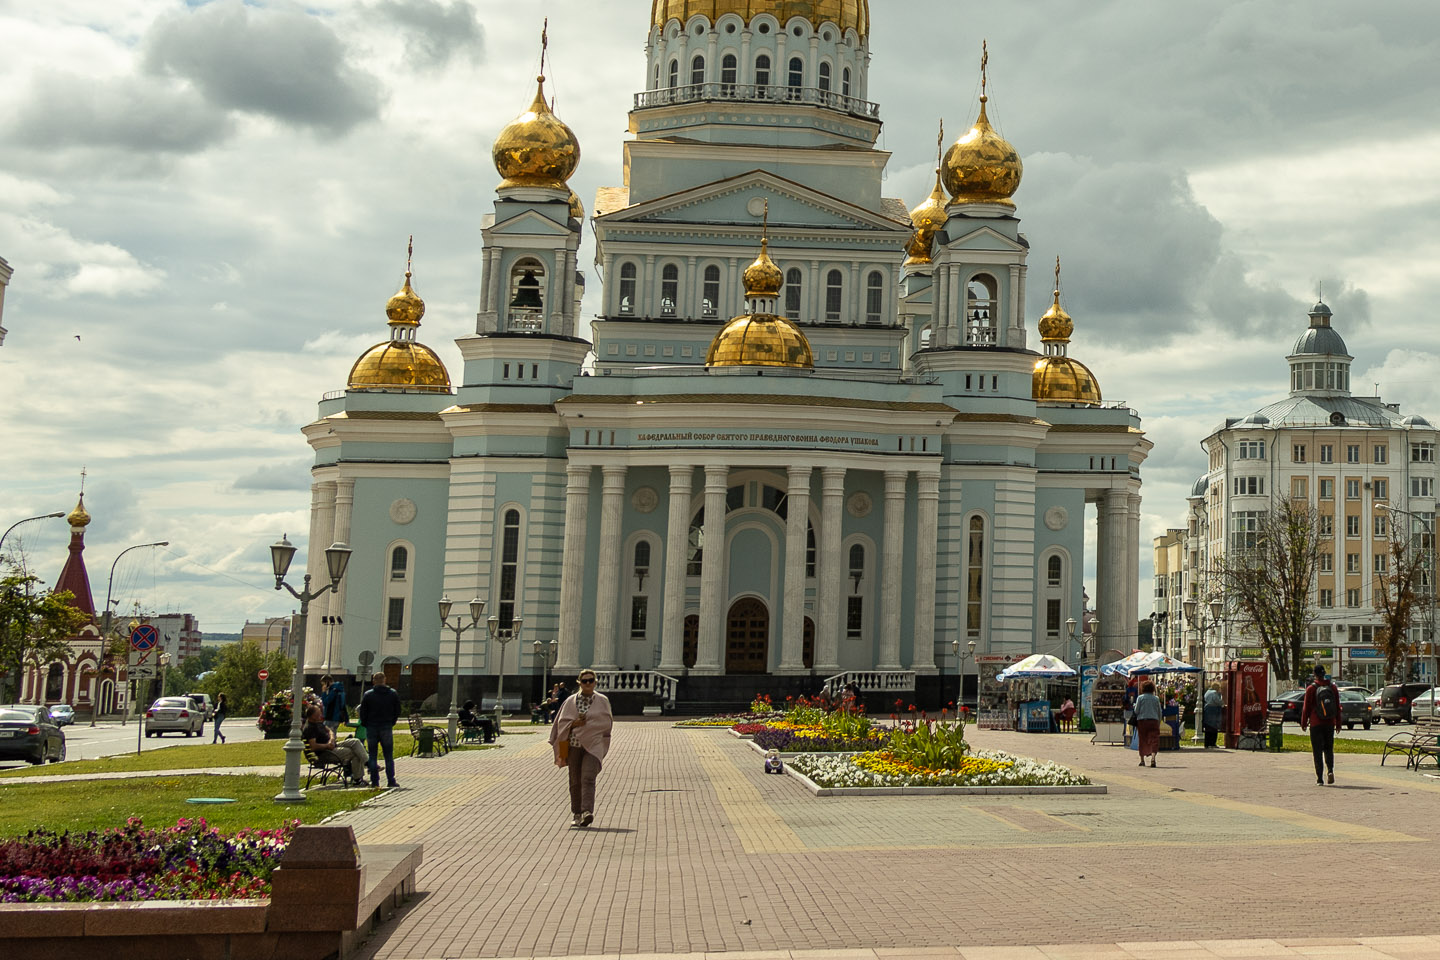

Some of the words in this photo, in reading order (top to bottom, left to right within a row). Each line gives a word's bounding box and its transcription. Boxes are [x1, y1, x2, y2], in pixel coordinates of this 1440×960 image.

[637, 432, 692, 441] КАФЕДРАЛЬНЫЙ
[693, 433, 715, 441] СОБОР
[716, 433, 748, 441] СВЯТОГО
[820, 436, 848, 444] ФЕОДОРА
[850, 437, 879, 446] УШАКОВА
